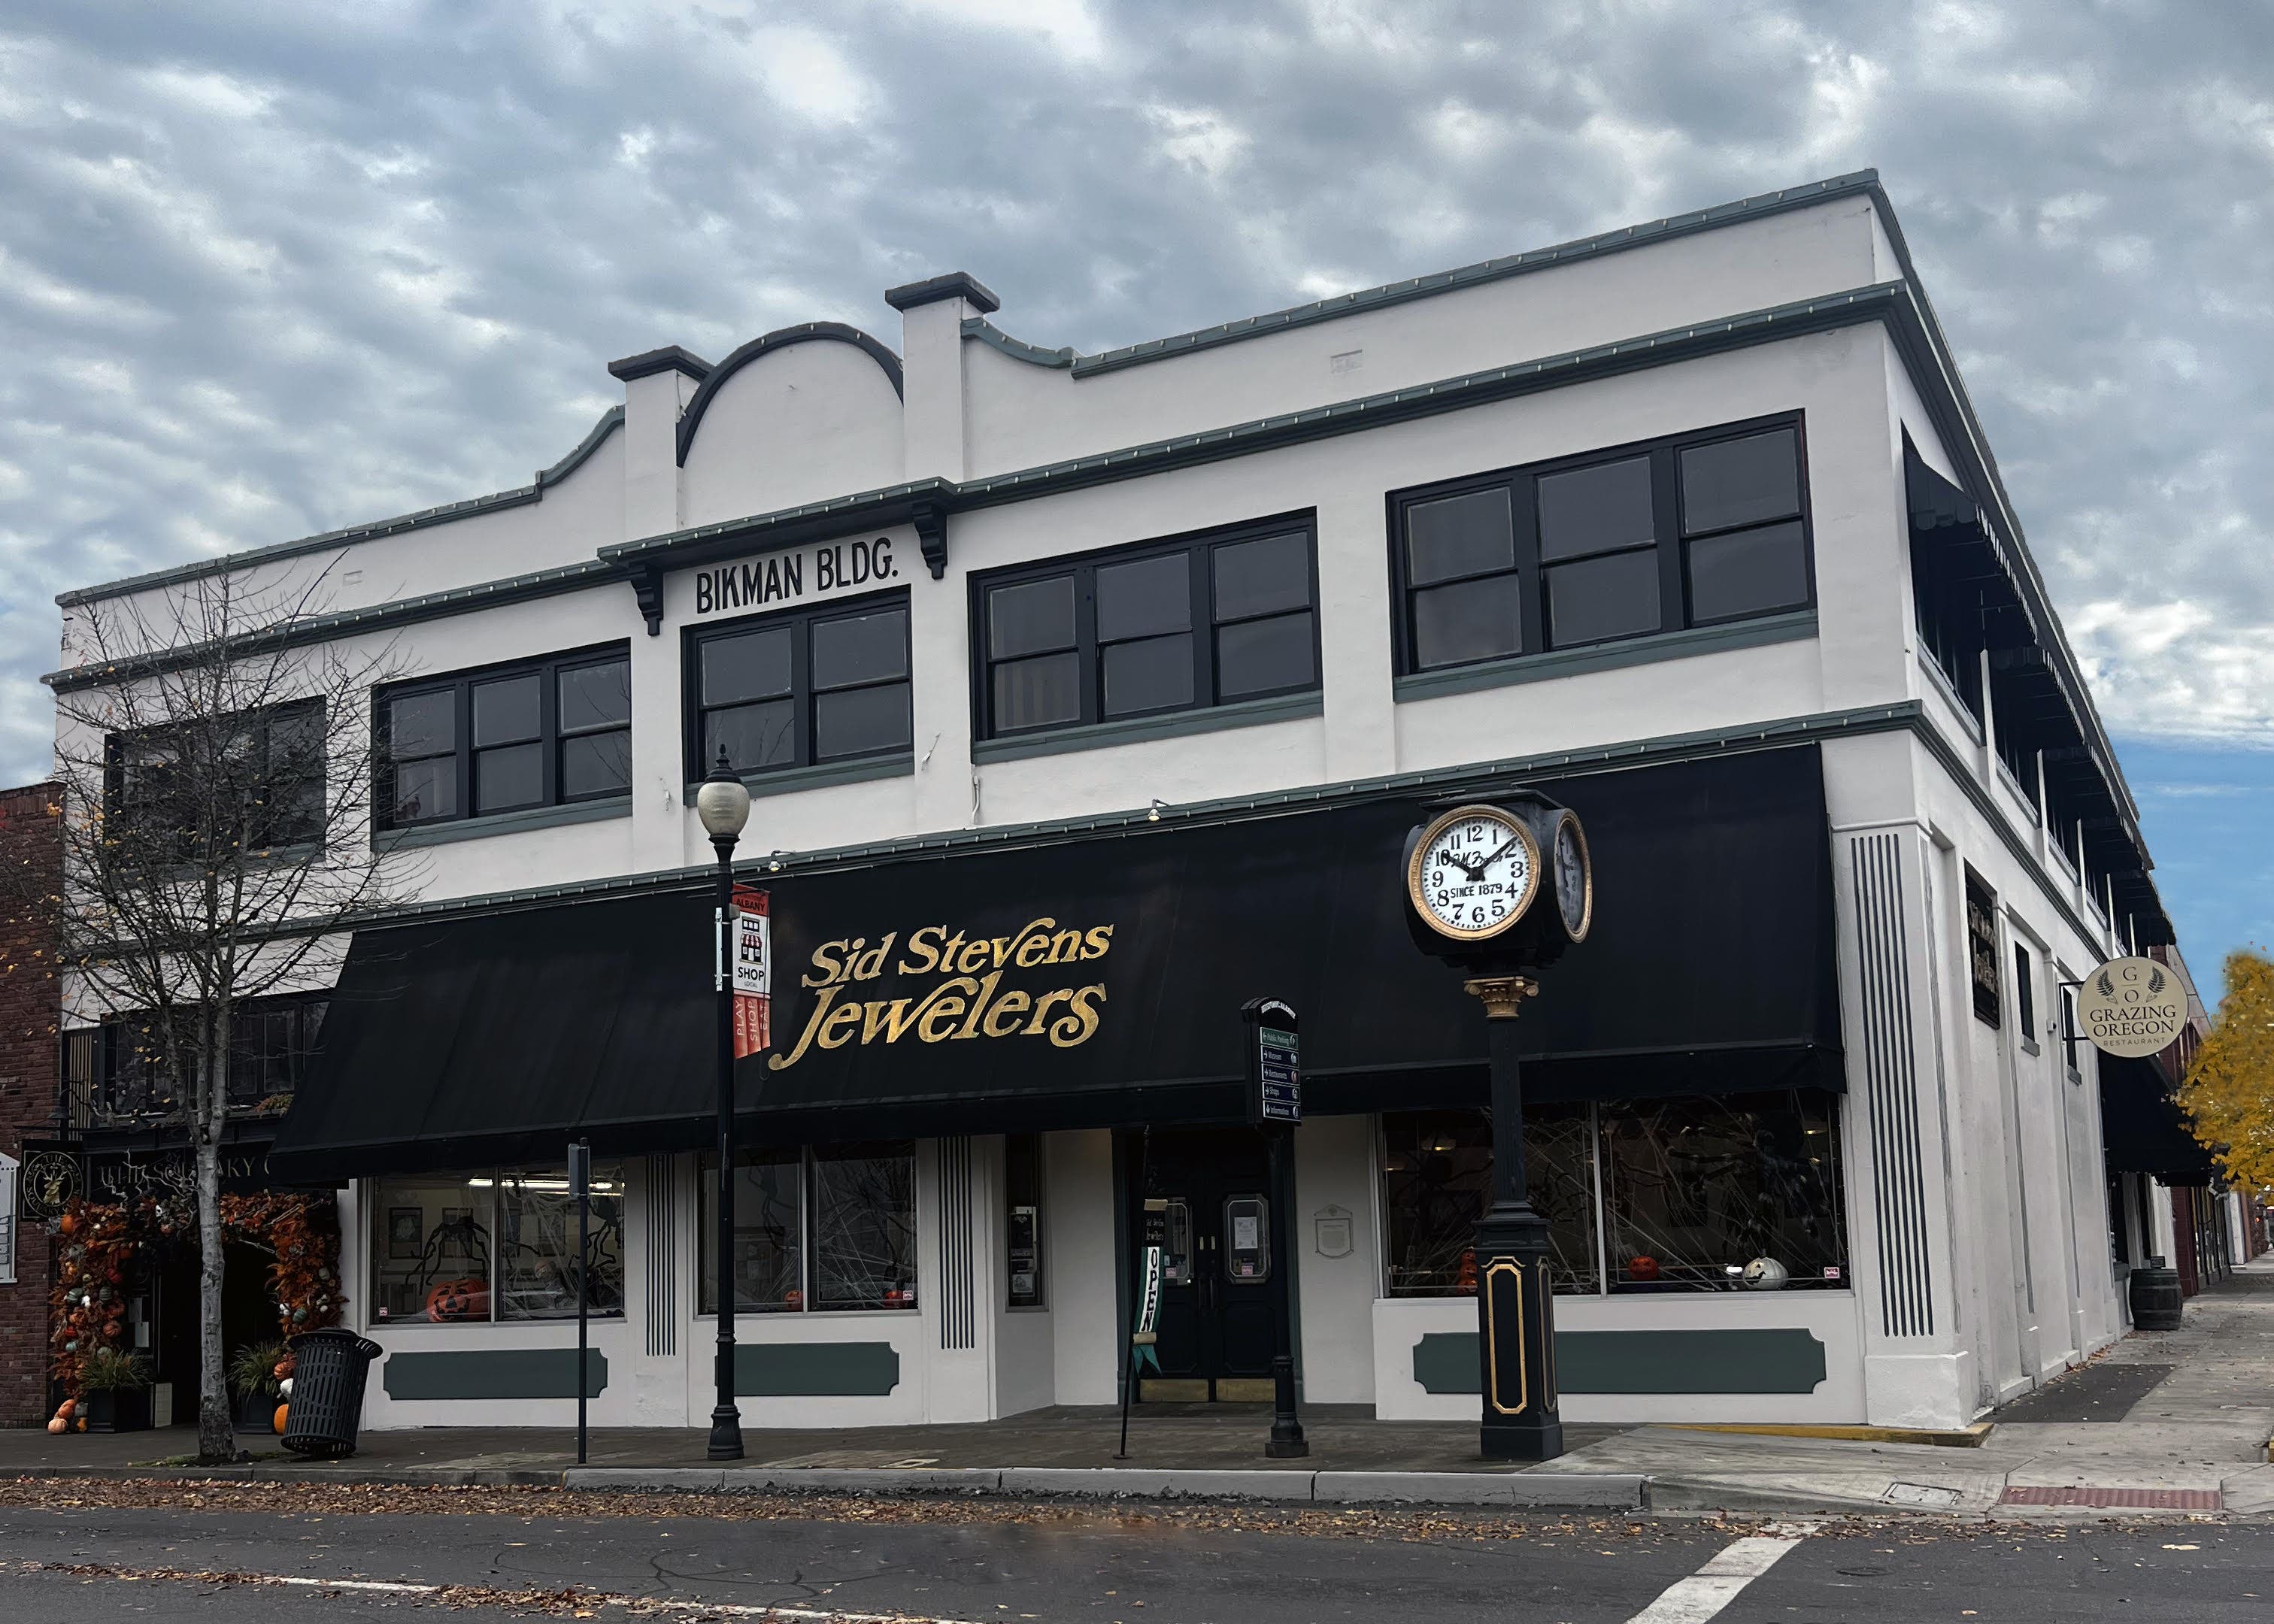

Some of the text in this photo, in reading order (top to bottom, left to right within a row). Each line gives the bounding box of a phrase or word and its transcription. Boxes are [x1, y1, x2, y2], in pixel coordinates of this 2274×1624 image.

[696, 538, 899, 614] BIKMAN BLDG.
[1450, 834, 1460, 850] 11
[1467, 826, 1484, 842] 12
[1492, 829, 1497, 844] 1
[1436, 850, 1450, 866] 10
[1511, 862, 1524, 878] 3
[1432, 871, 1444, 887] 9
[1437, 889, 1449, 906] 8
[1451, 883, 1502, 898] SINCE 1879
[1505, 882, 1518, 898] 4
[736, 898, 766, 912] ALBANY
[1452, 904, 1464, 920] 7
[1492, 899, 1505, 917] 5
[1472, 907, 1485, 923] 6
[802, 917, 1114, 988] Sid Stevens
[738, 966, 765, 982] SHOP
[2123, 966, 2137, 981] G
[2124, 989, 2139, 1003] O
[735, 999, 745, 1037] PLAY
[747, 1001, 758, 1041] SHOP
[768, 970, 1107, 1071] Jewelers
[2090, 1004, 2175, 1023] GRAZING
[2094, 1020, 2174, 1038] OREGON
[2103, 1038, 2165, 1047] RESTAURANT
[43, 1154, 65, 1163] THE
[1142, 1249, 1158, 1332] OPEN
